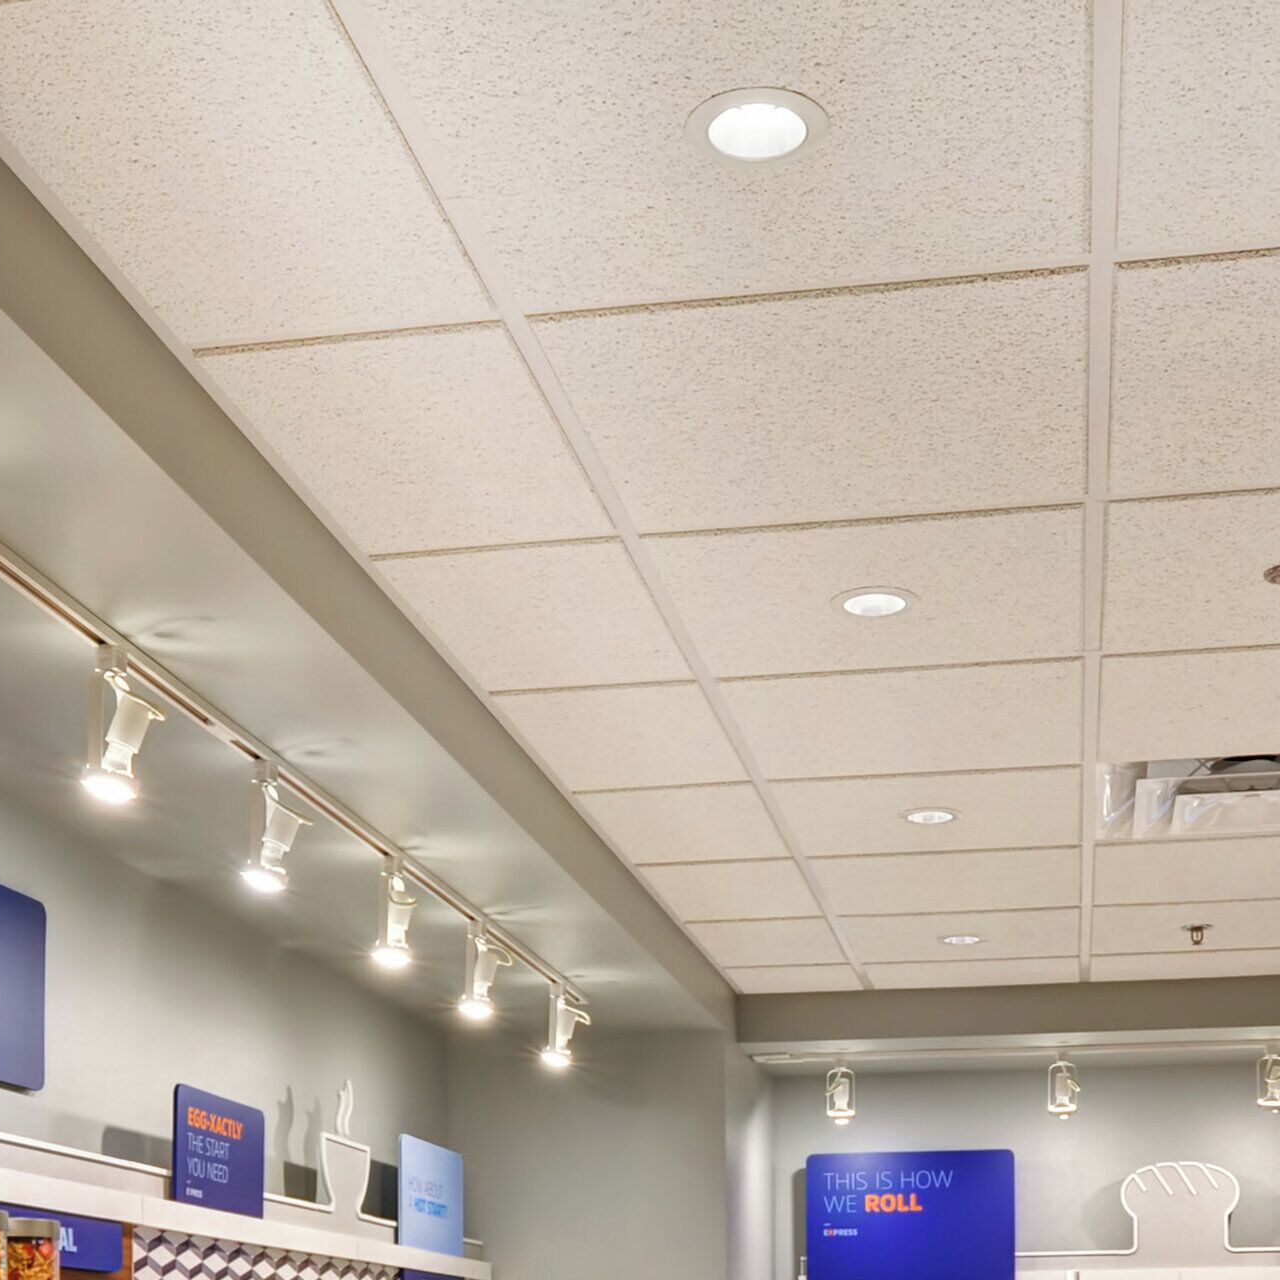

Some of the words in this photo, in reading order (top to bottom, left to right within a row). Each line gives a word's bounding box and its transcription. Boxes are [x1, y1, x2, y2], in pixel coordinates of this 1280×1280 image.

[187, 1106, 243, 1140] EGG-XACTLY
[187, 1132, 203, 1154] THE
[205, 1138, 230, 1160] START
[187, 1157, 205, 1178] YOU
[207, 1161, 228, 1183] NEED
[823, 1171, 868, 1190] THIS
[876, 1171, 893, 1189] IS
[900, 1170, 953, 1189] HOW
[823, 1194, 857, 1213] WE
[865, 1193, 923, 1213] ROLL
[823, 1228, 858, 1237] EXPRESS
